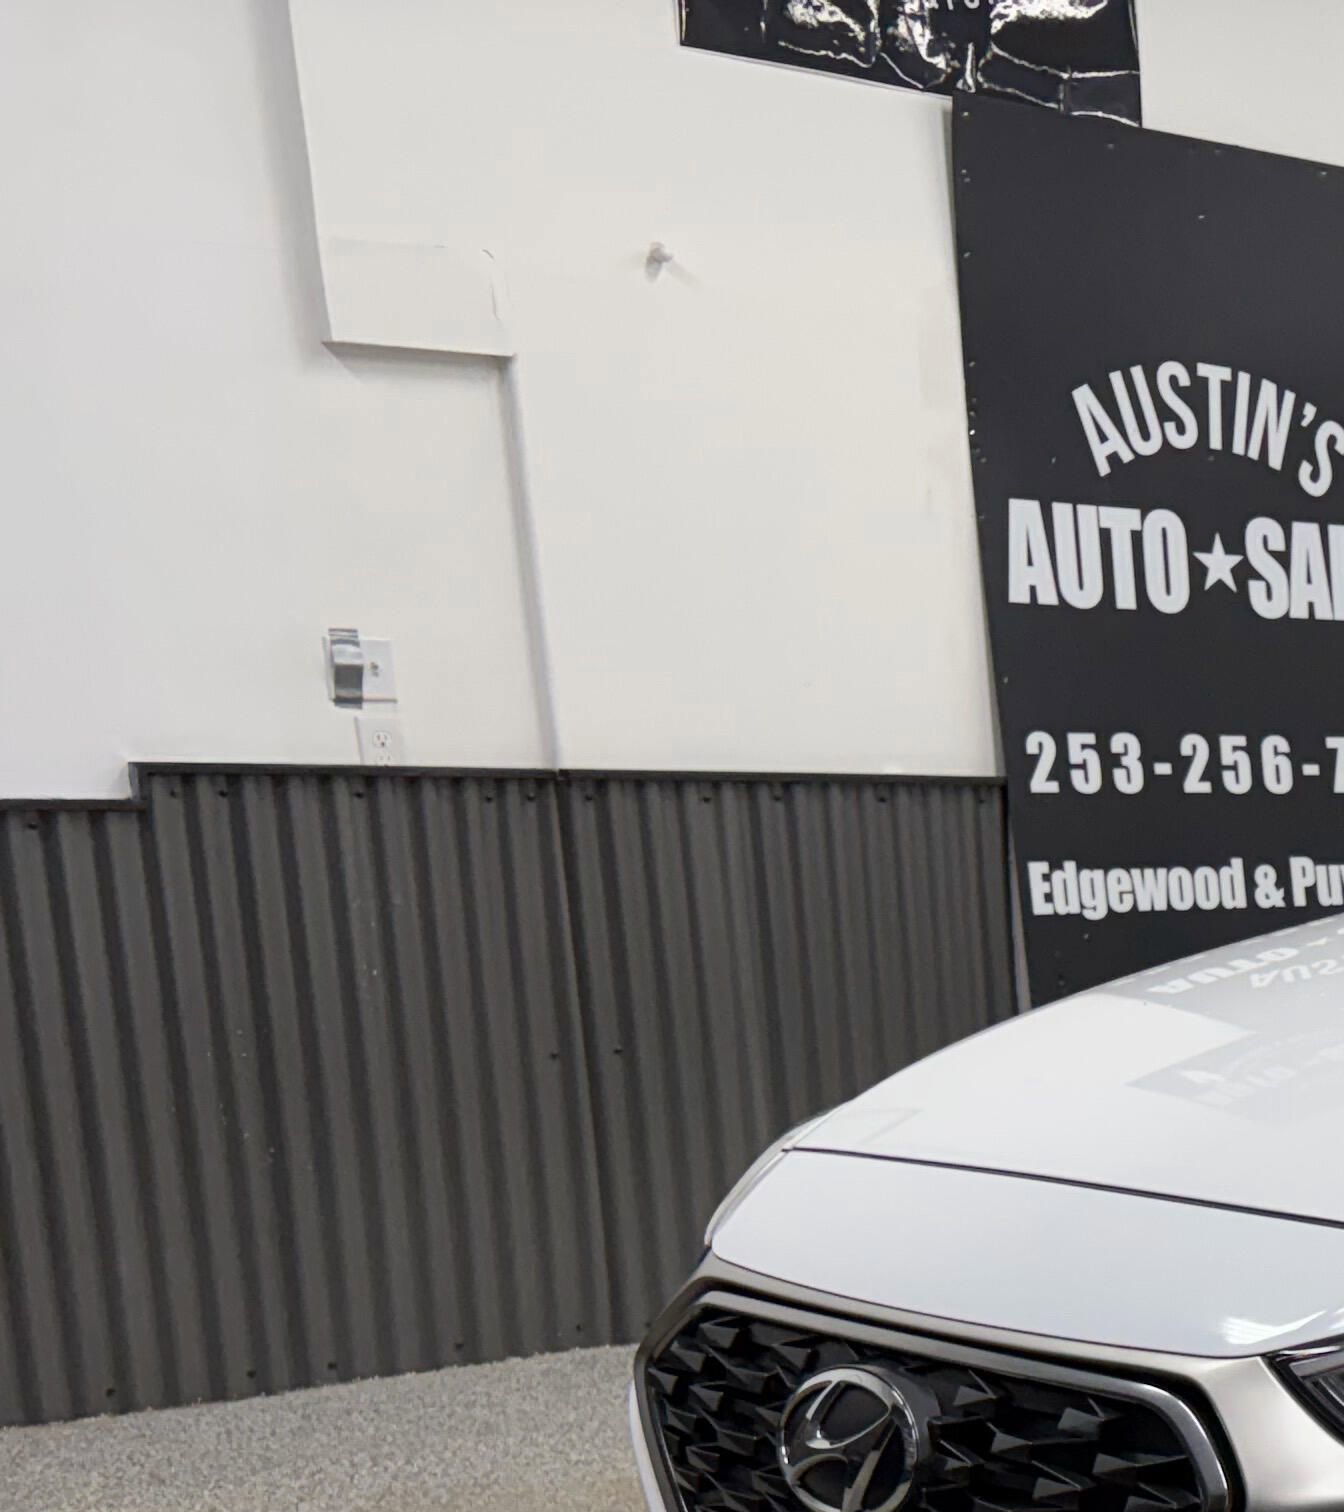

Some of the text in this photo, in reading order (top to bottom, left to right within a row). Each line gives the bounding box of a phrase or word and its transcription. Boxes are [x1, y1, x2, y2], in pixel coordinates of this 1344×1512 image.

[1009, 499, 1190, 614] AUTO
[1028, 857, 1247, 921] Edgewood
[1254, 864, 1286, 909] &
